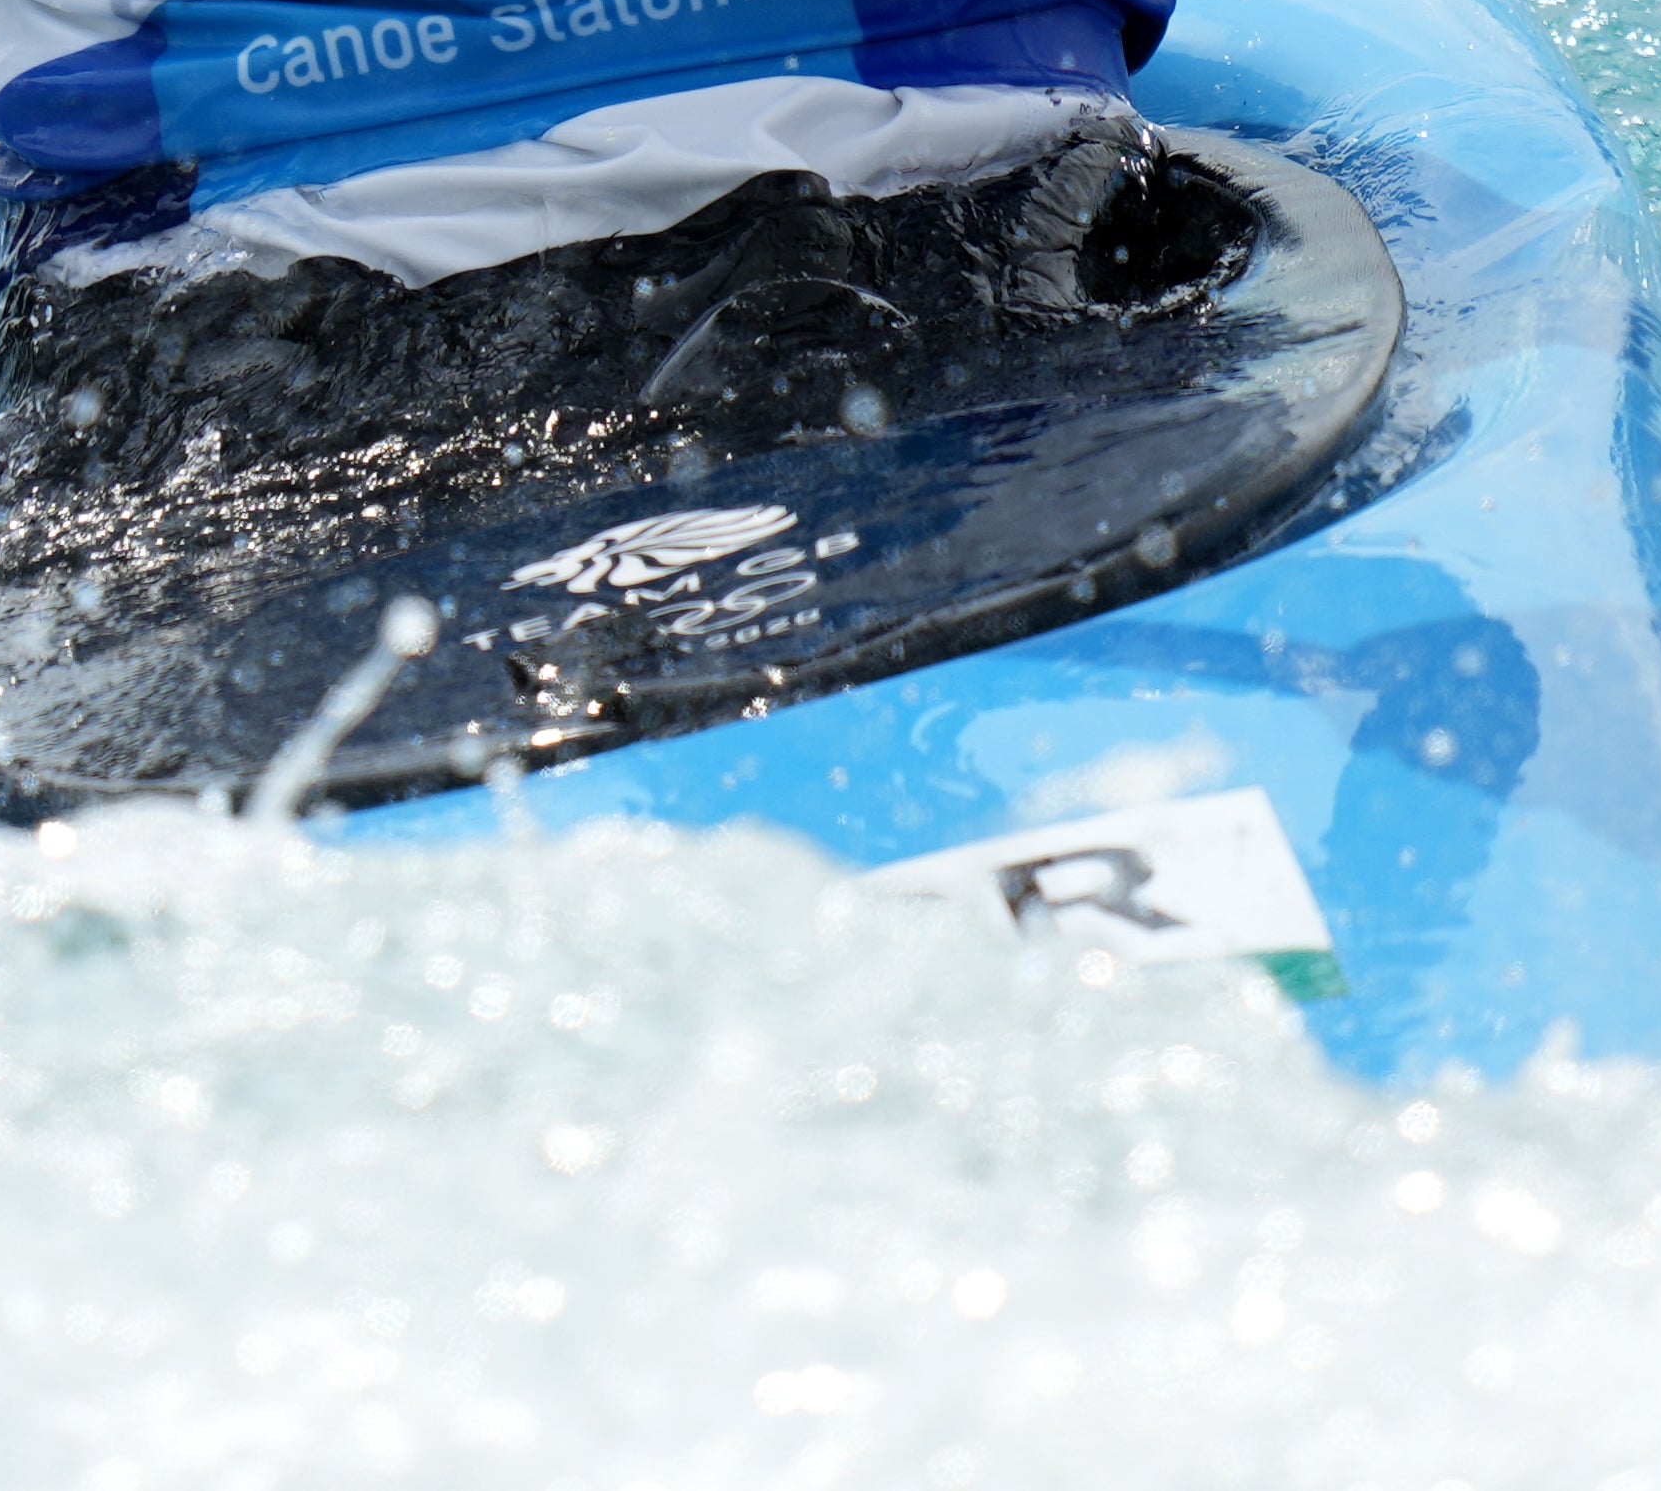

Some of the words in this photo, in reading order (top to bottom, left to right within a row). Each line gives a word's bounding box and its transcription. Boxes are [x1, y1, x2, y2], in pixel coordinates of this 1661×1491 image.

[236, 14, 458, 95] Canoe
[462, 570, 701, 652] TEAM
[735, 529, 861, 578] GB
